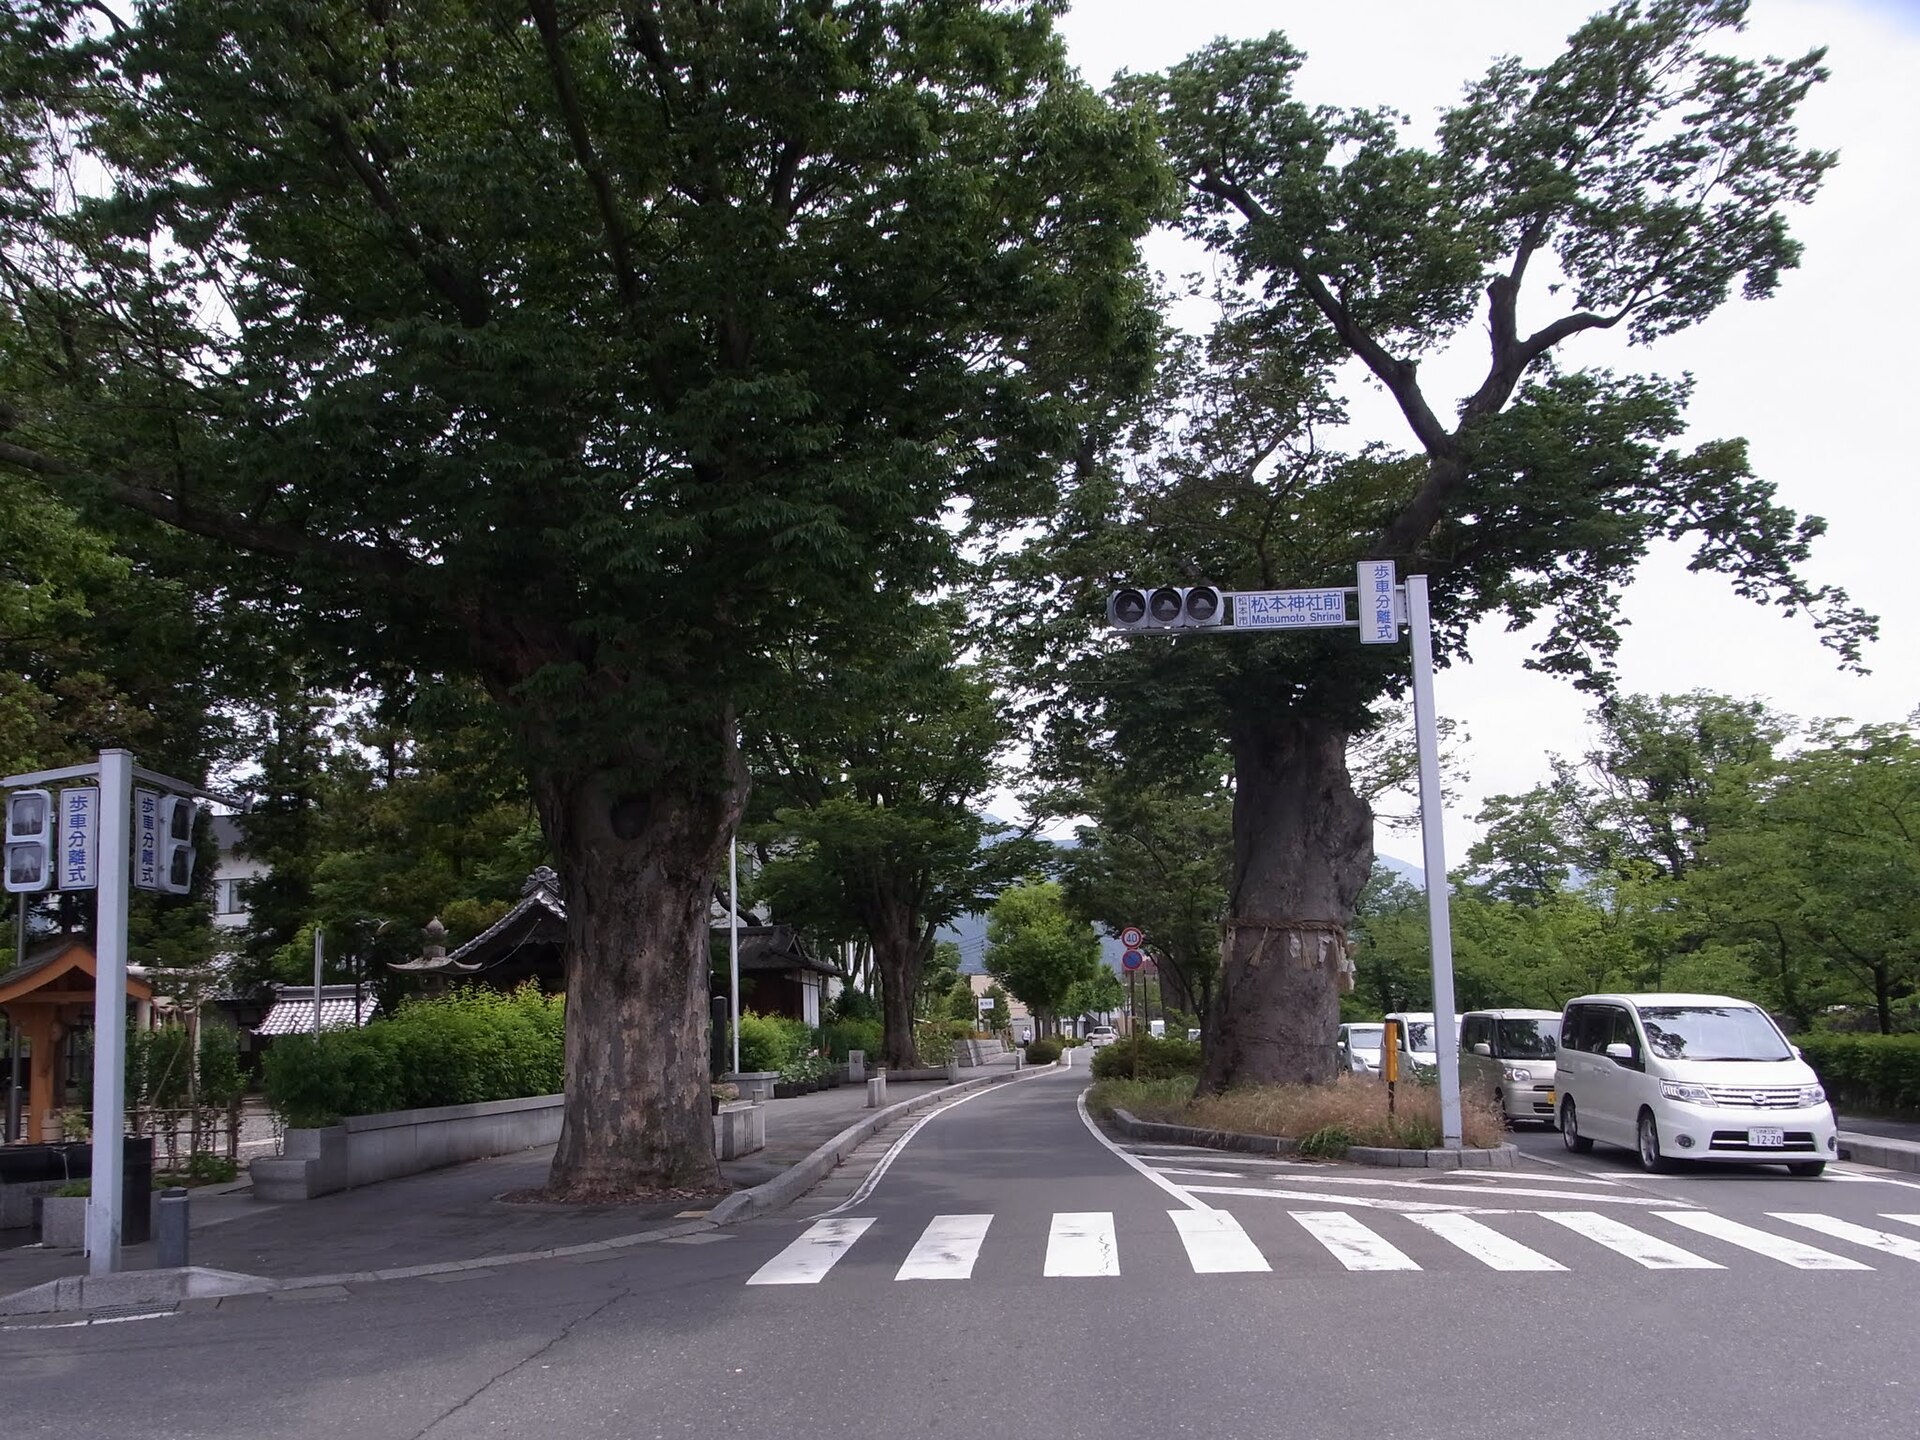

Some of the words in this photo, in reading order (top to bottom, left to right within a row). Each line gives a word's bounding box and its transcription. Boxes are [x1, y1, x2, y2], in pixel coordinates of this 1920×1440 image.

[1238, 597, 1247, 625] 松本市
[1251, 594, 1340, 613] 松本神社前
[1375, 565, 1392, 639] 歩車分離式
[1252, 614, 1305, 624] Matsumoto
[1310, 612, 1341, 622] Shrine
[69, 796, 87, 882] 歩車分離式
[142, 798, 154, 883] 歩車分離式
[1126, 933, 1137, 942] 40
[1757, 1135, 1782, 1144] 12-20
